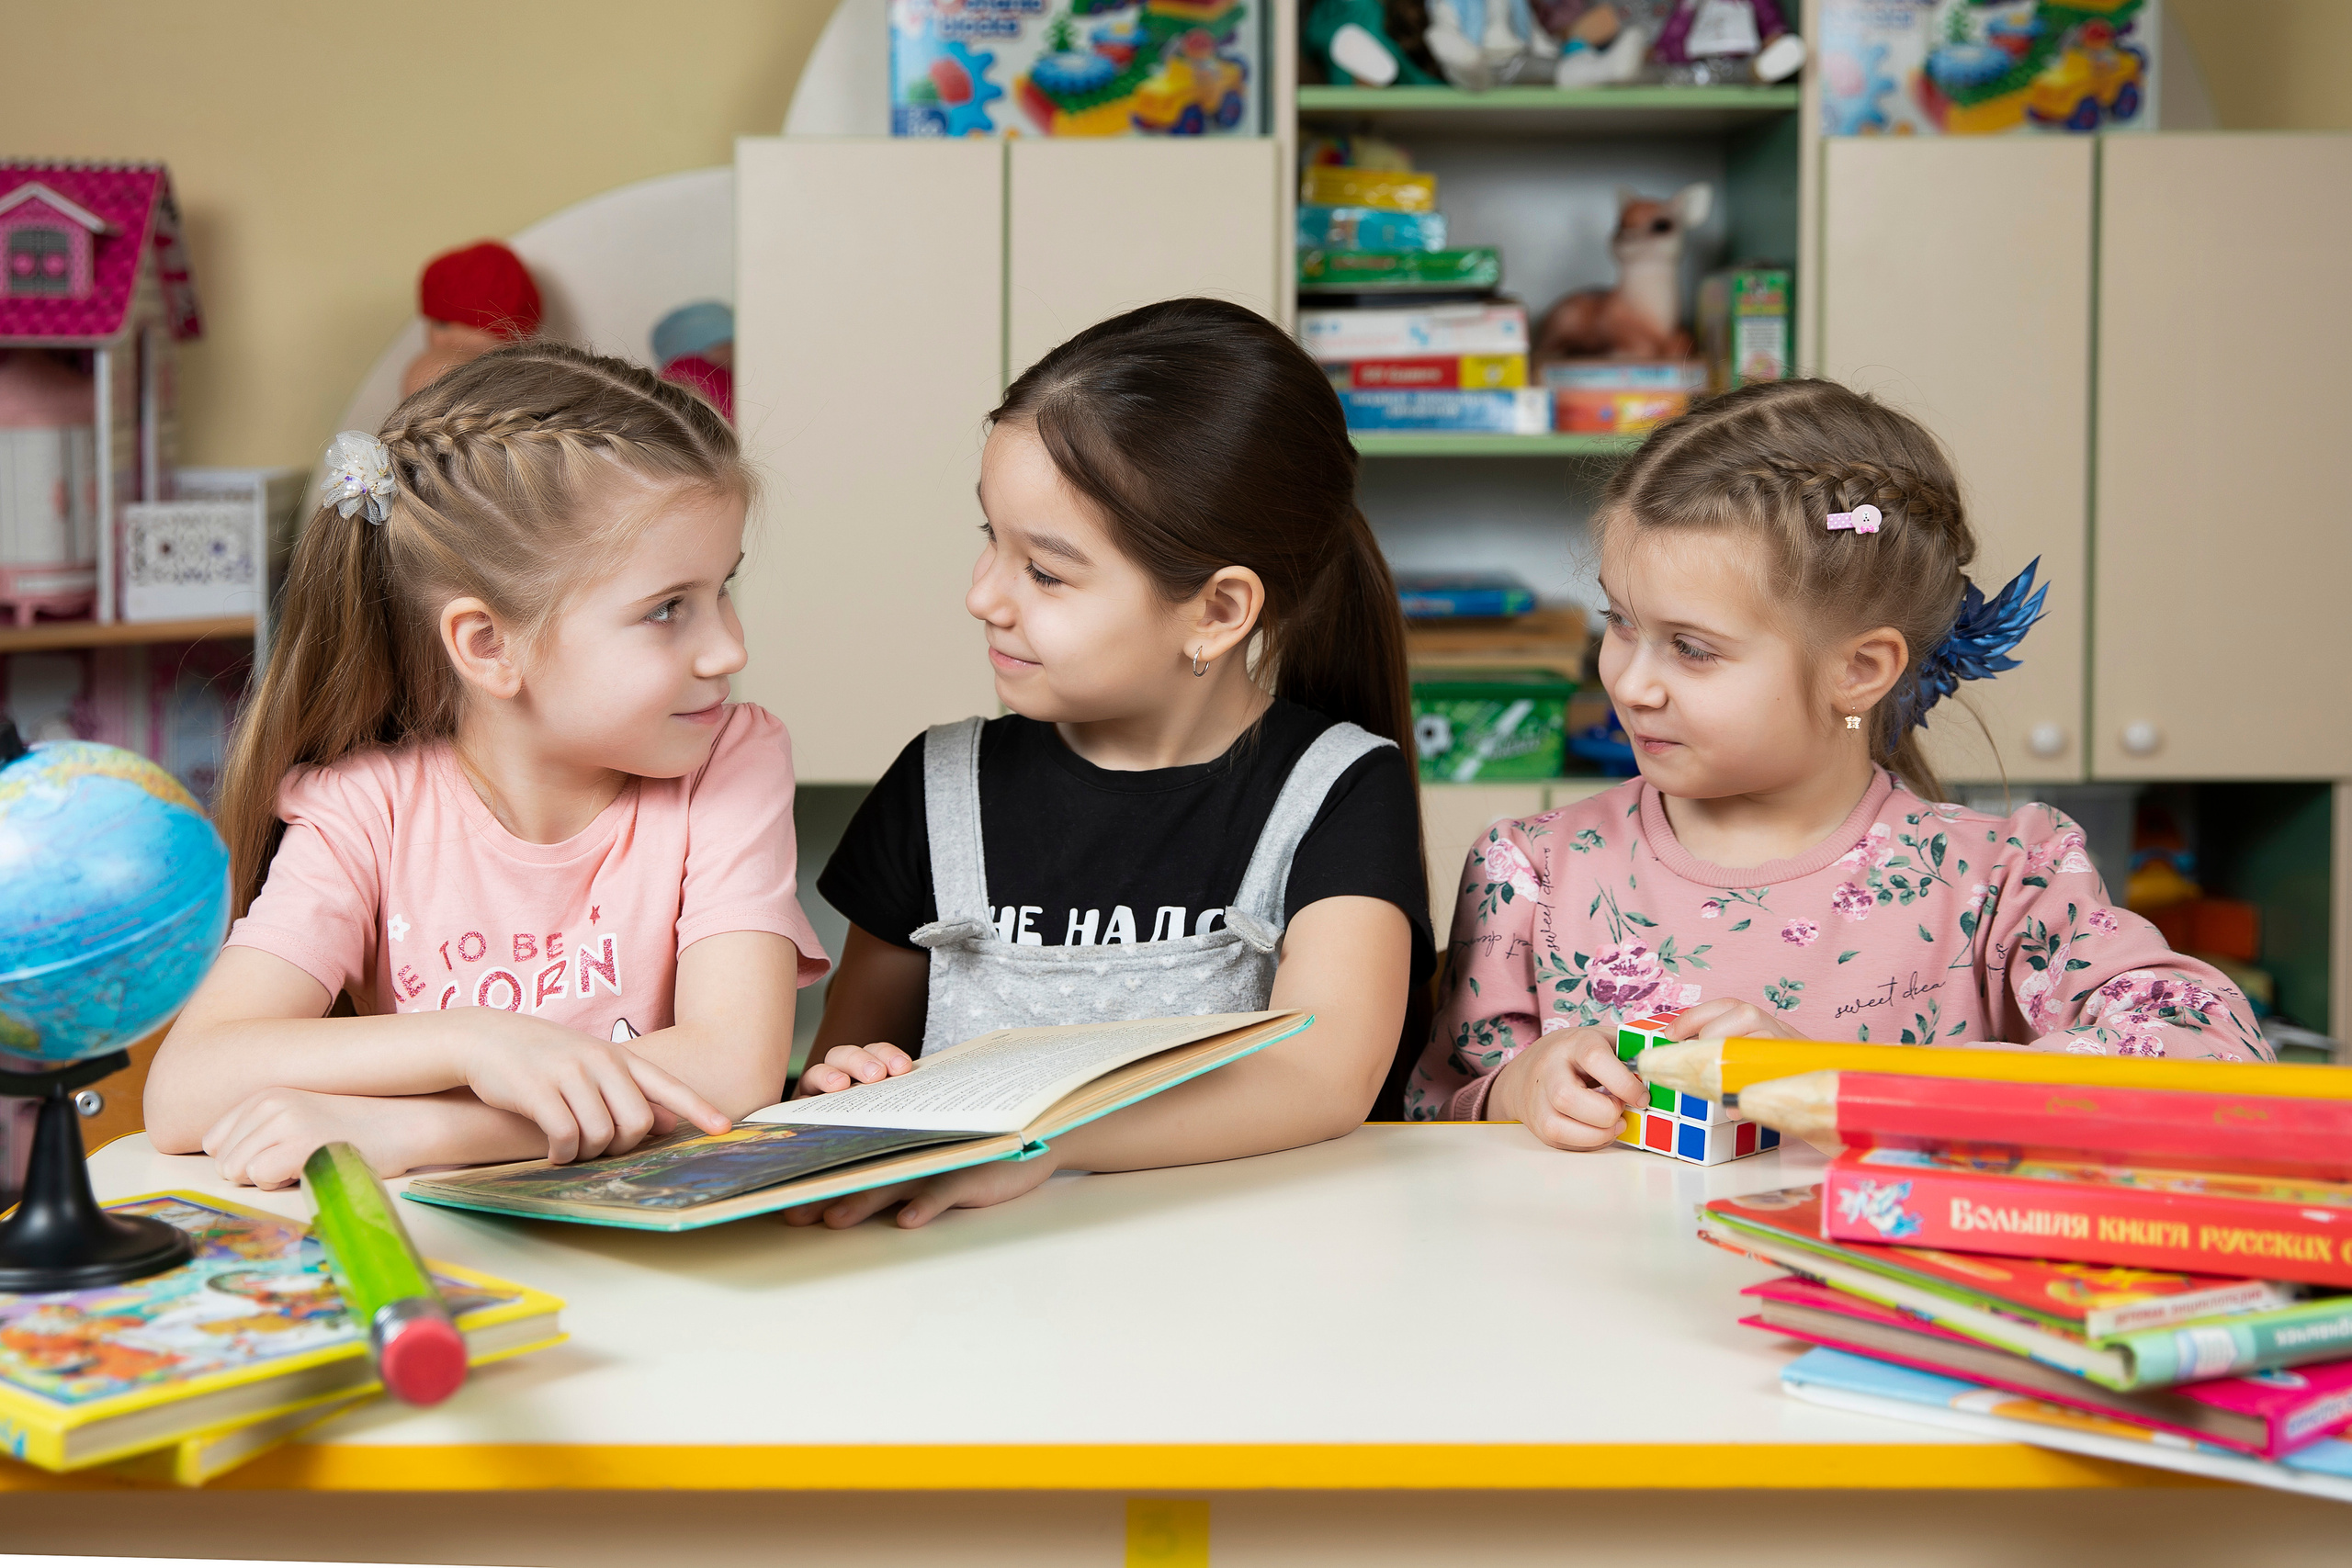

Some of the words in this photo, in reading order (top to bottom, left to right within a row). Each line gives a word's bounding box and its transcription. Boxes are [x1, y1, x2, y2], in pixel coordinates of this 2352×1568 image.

[393, 964, 426, 1004] E
[439, 931, 487, 972] TO
[514, 931, 565, 963] BE
[1835, 976, 1899, 1019] sweet
